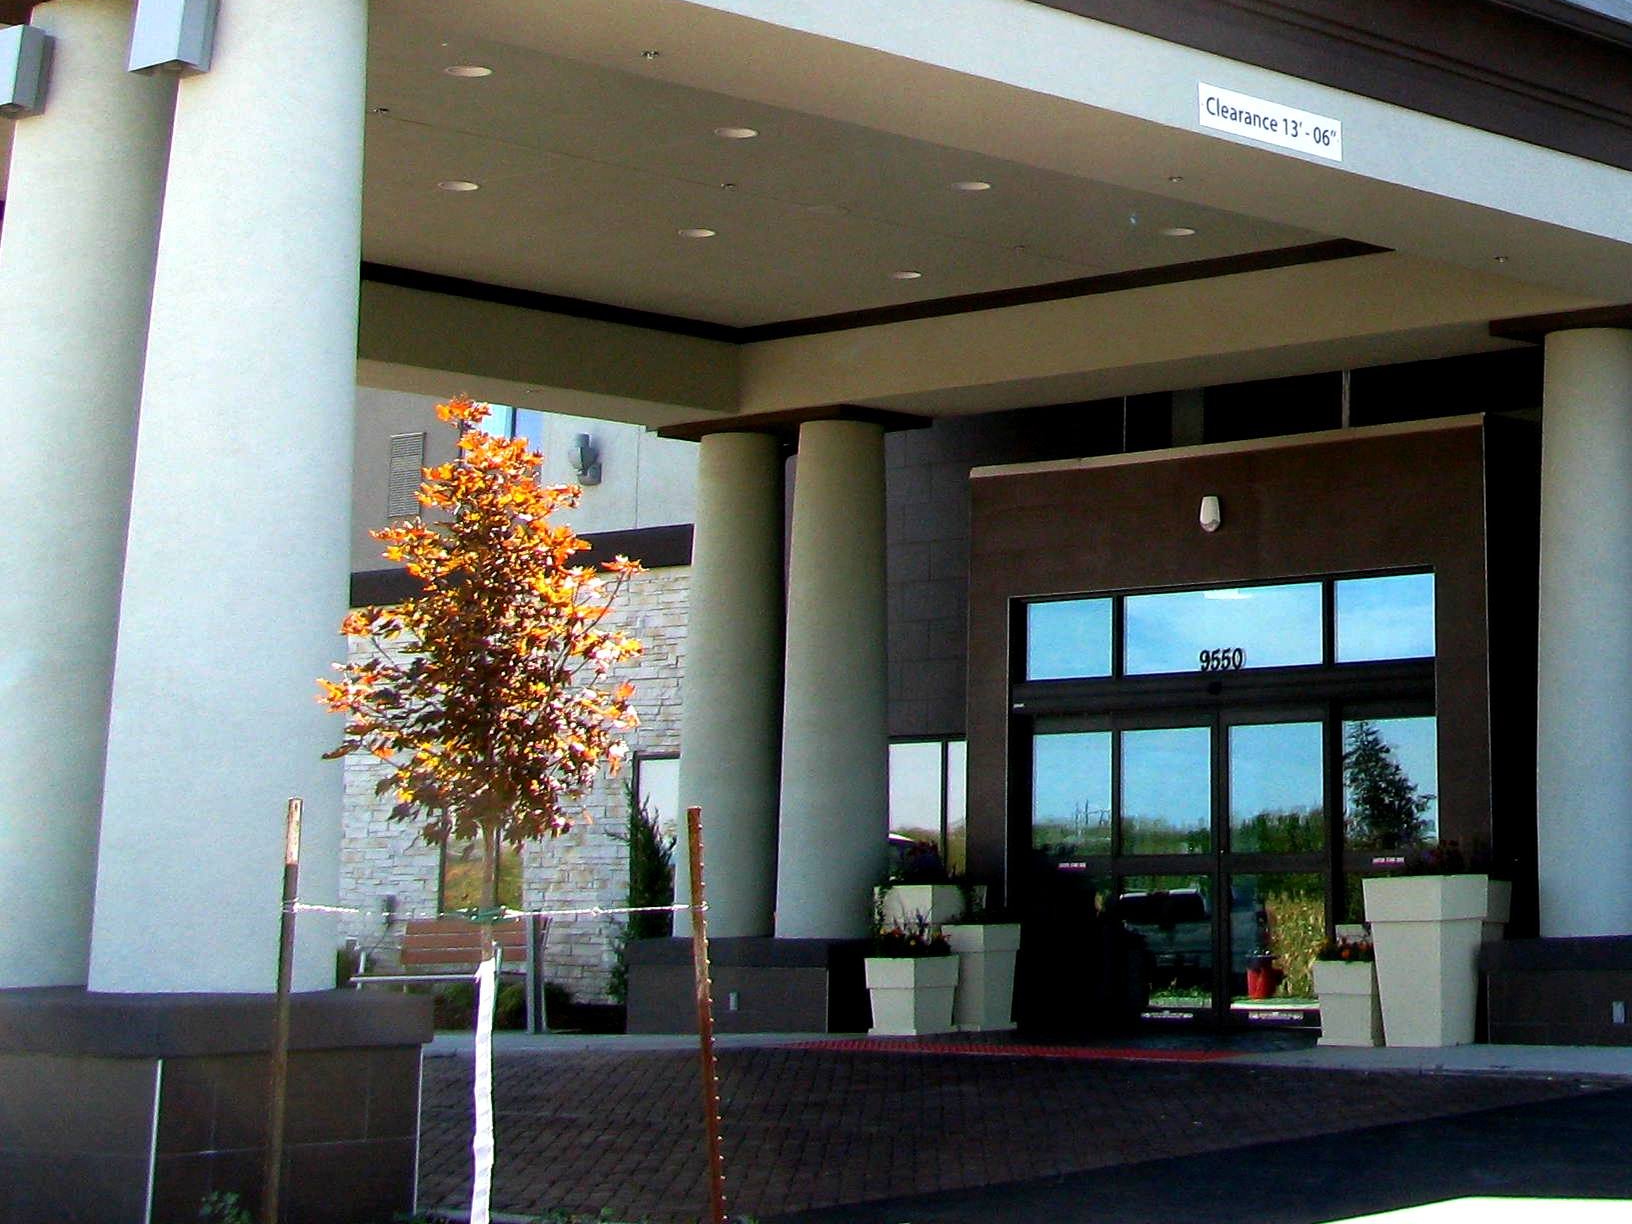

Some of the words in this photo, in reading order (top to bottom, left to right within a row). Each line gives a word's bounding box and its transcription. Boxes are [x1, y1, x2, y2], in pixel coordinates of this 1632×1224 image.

[1206, 97, 1278, 132] Clearance
[1283, 118, 1302, 137] 13'
[1199, 647, 1243, 672] 9550
